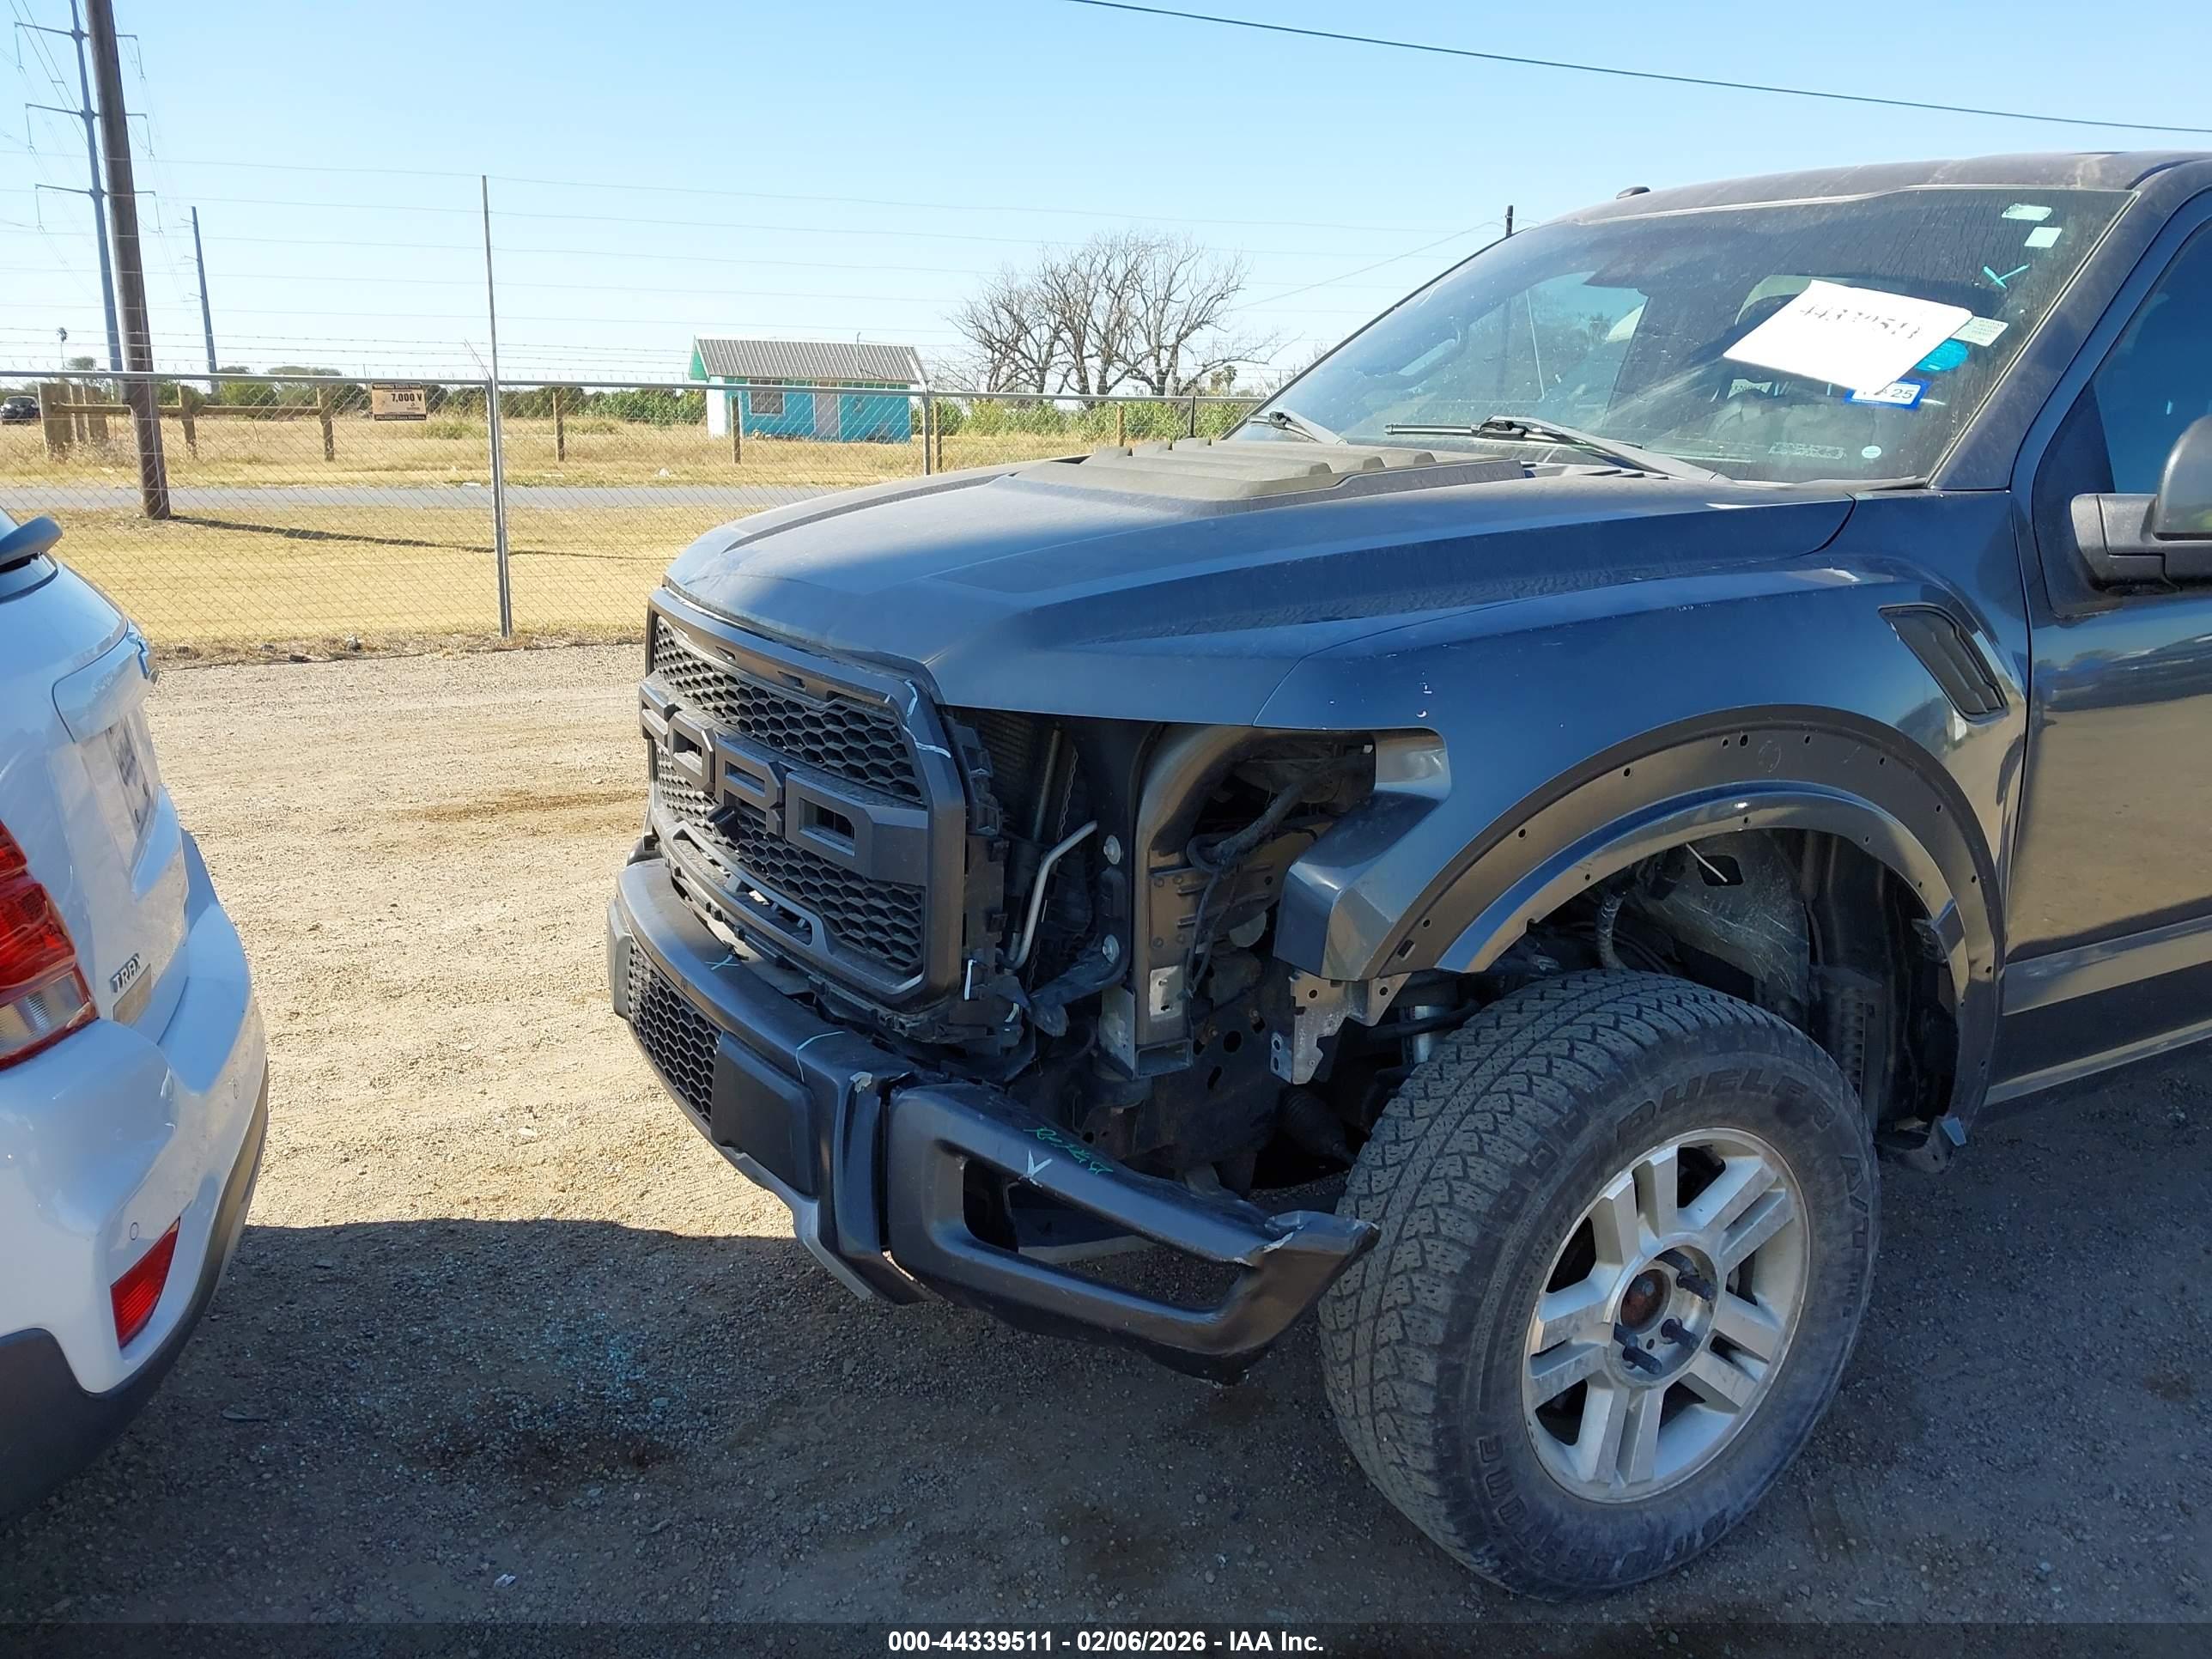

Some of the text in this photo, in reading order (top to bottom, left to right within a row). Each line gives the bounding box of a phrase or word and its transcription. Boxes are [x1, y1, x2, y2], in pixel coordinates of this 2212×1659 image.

[391, 392, 422, 403] 7,000 V
[1890, 388, 1915, 399] 25
[639, 681, 873, 883] FORD
[110, 953, 141, 994] TRAX
[1615, 1067, 1837, 1145] DUELER
